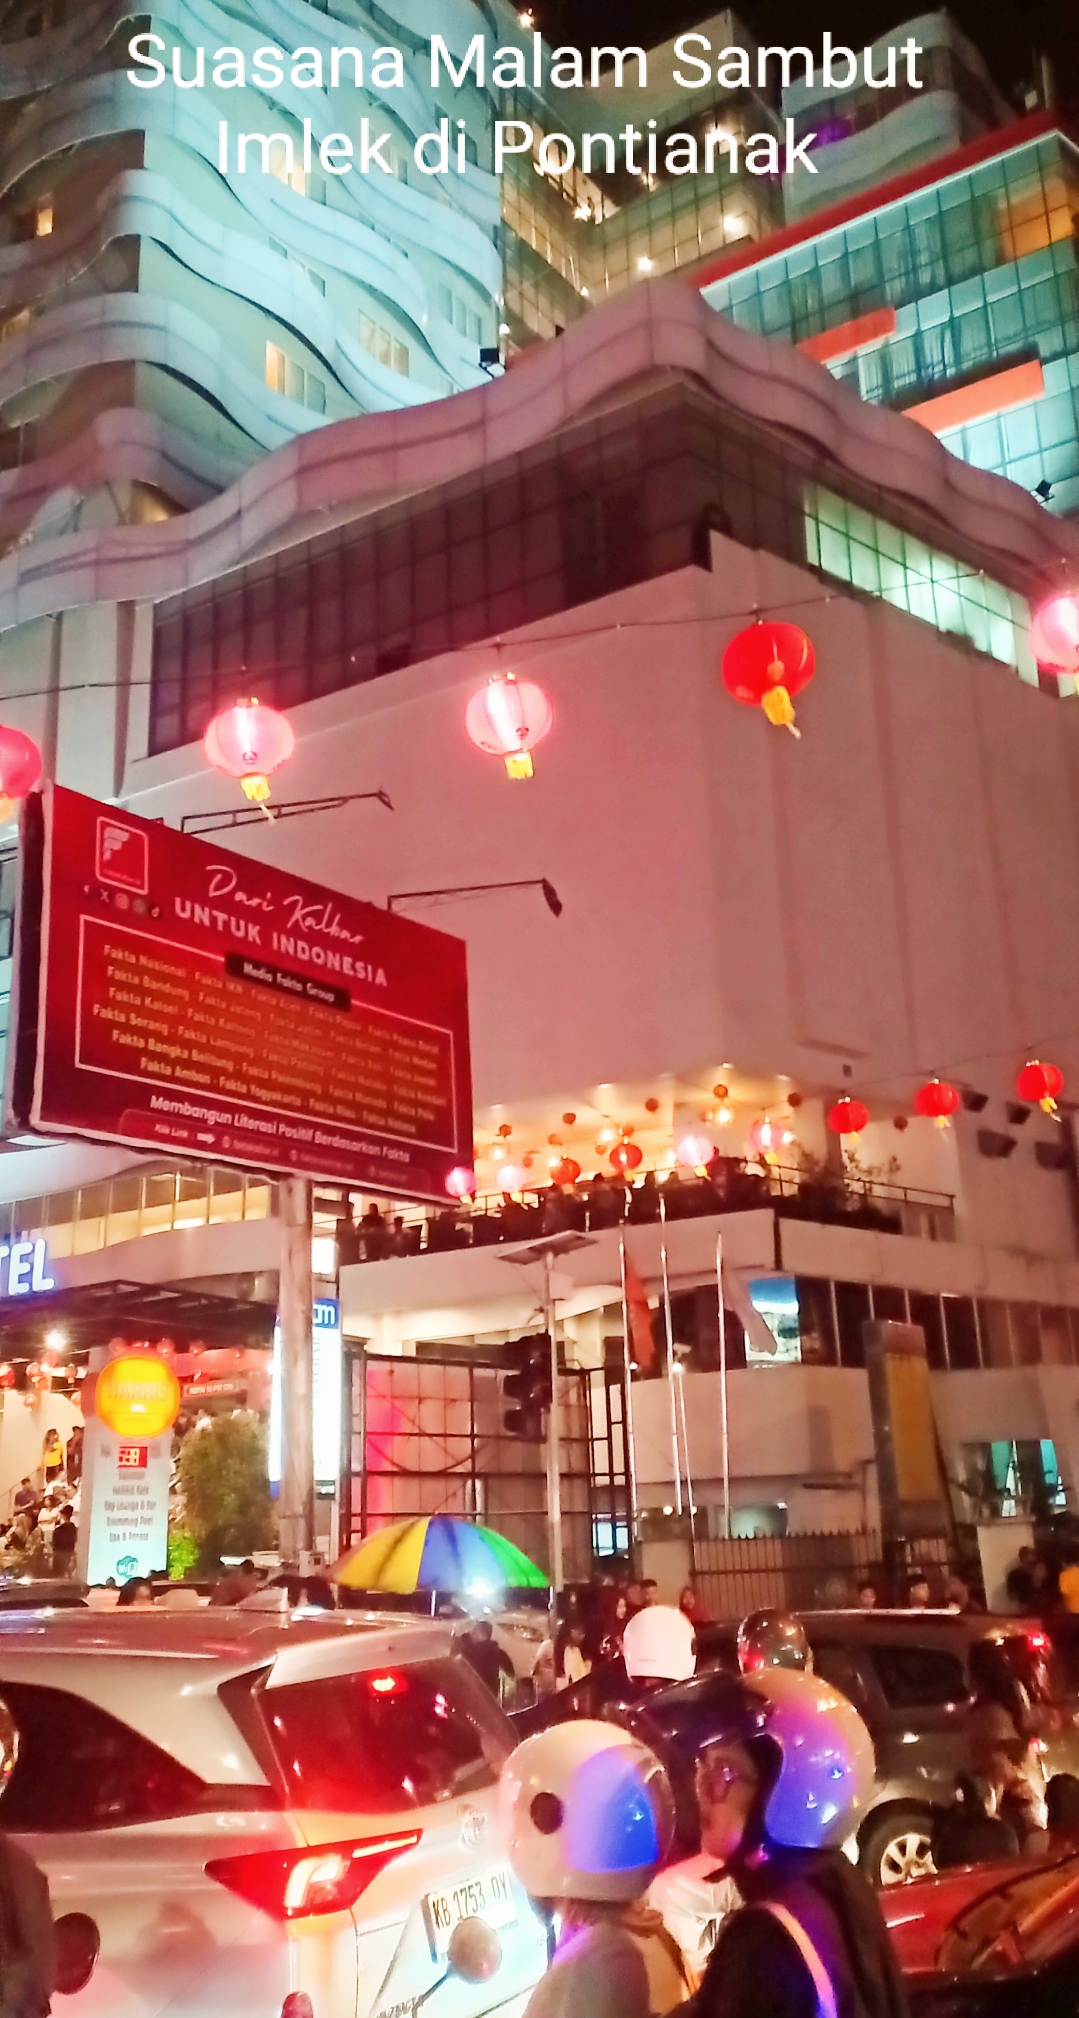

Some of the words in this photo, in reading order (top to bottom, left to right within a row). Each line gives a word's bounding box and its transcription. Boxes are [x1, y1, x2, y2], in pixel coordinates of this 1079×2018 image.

[206, 865, 274, 911] Dari
[283, 896, 364, 943] Kalbar
[174, 897, 262, 945] UNTUK
[272, 932, 387, 986] INDONESIA
[104, 944, 135, 964] Fakta
[139, 954, 185, 978] Nasional
[194, 971, 222, 989] Fakta
[107, 965, 139, 985] Fakta
[142, 975, 189, 1001] Bandung
[199, 991, 225, 1010] Fakta
[243, 961, 272, 982] Media
[276, 971, 302, 992] Fakta
[306, 981, 334, 1004] Group
[109, 986, 140, 1005] Fakta
[187, 1007, 215, 1025] Fakta
[93, 1003, 125, 1023] Fakta
[129, 1012, 168, 1036] Serang
[178, 1025, 206, 1043] Fakta
[209, 1034, 253, 1058] Lampung
[112, 1029, 144, 1049] Fakta
[148, 1038, 188, 1060] Bangka
[192, 1049, 233, 1073] Belitung
[242, 1062, 268, 1079] Fakta
[140, 1057, 171, 1075] Fakta
[174, 1065, 210, 1084] Ambon
[219, 1076, 246, 1093] Fakta
[250, 1084, 301, 1106] Yogyakarta
[150, 1095, 231, 1125] Membangun
[234, 1112, 275, 1134] Literasi
[278, 1122, 312, 1142] Positif
[314, 1130, 380, 1157] Berdasarkan
[382, 1145, 409, 1163] Fakta
[432, 1897, 451, 1930] KB
[453, 1881, 486, 1921] 1753
